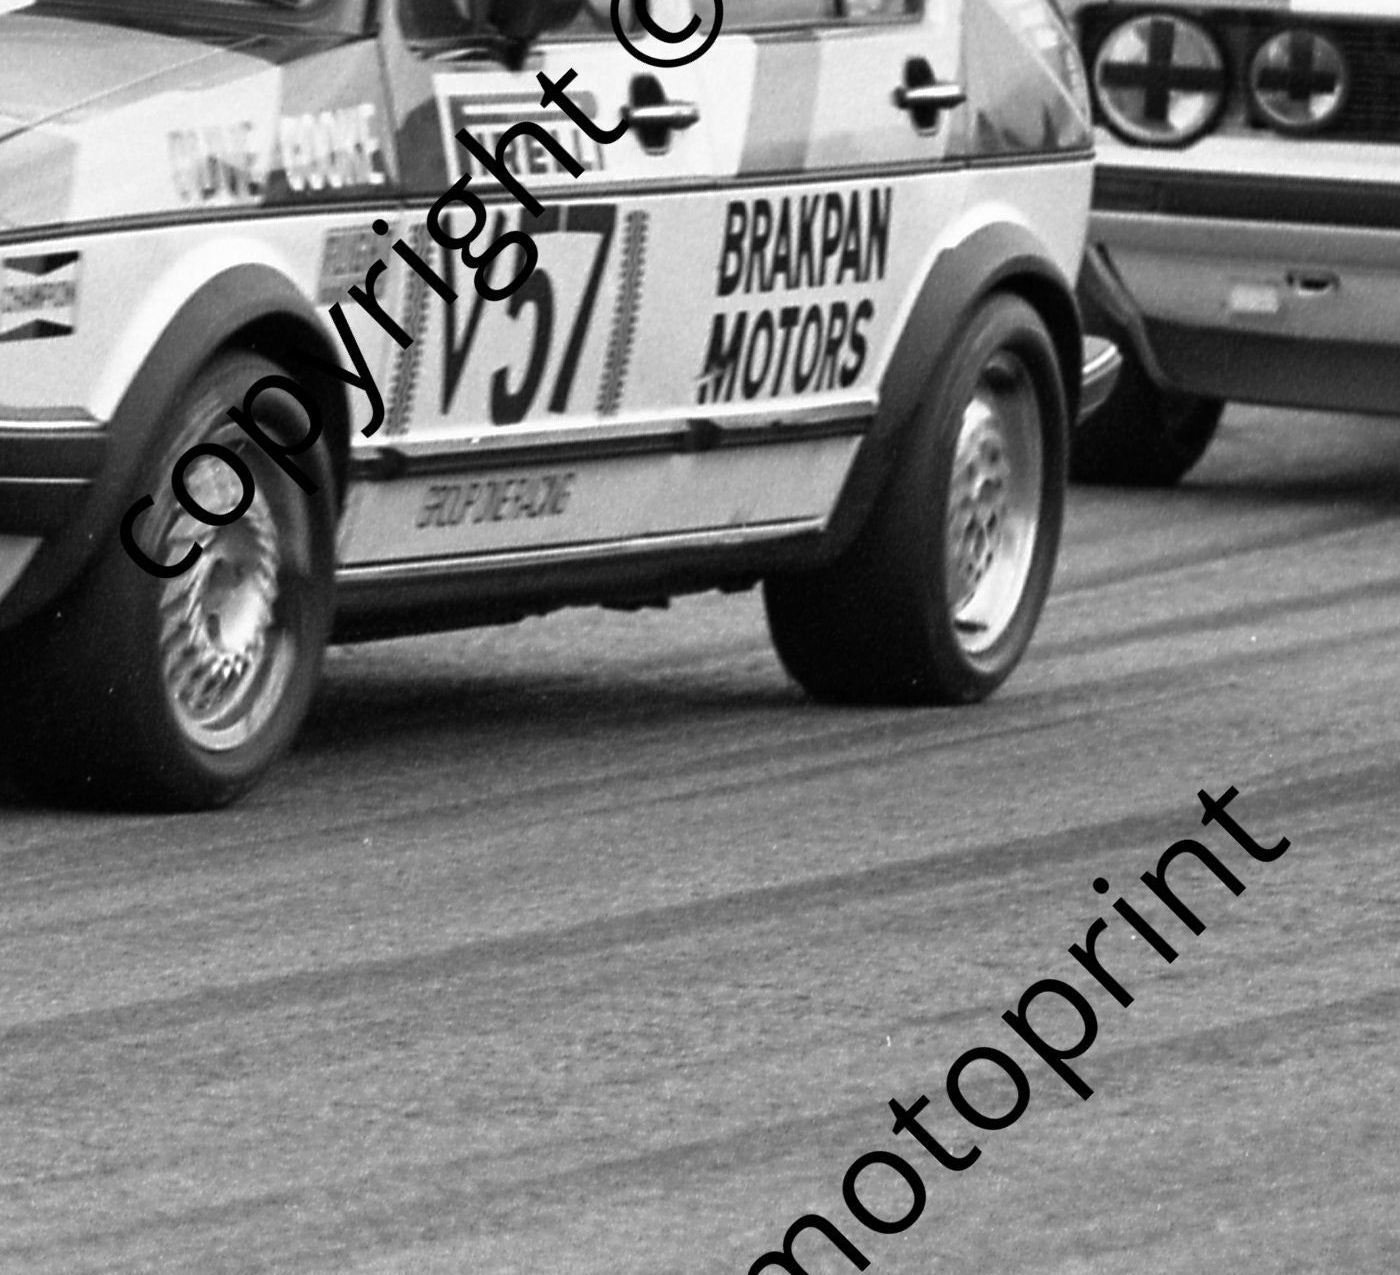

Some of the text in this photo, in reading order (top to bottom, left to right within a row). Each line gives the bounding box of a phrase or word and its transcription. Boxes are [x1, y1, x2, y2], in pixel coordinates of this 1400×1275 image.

[715, 185, 892, 298] BRAKPAN
[441, 203, 618, 427] V57
[699, 298, 875, 407] MOTORS
